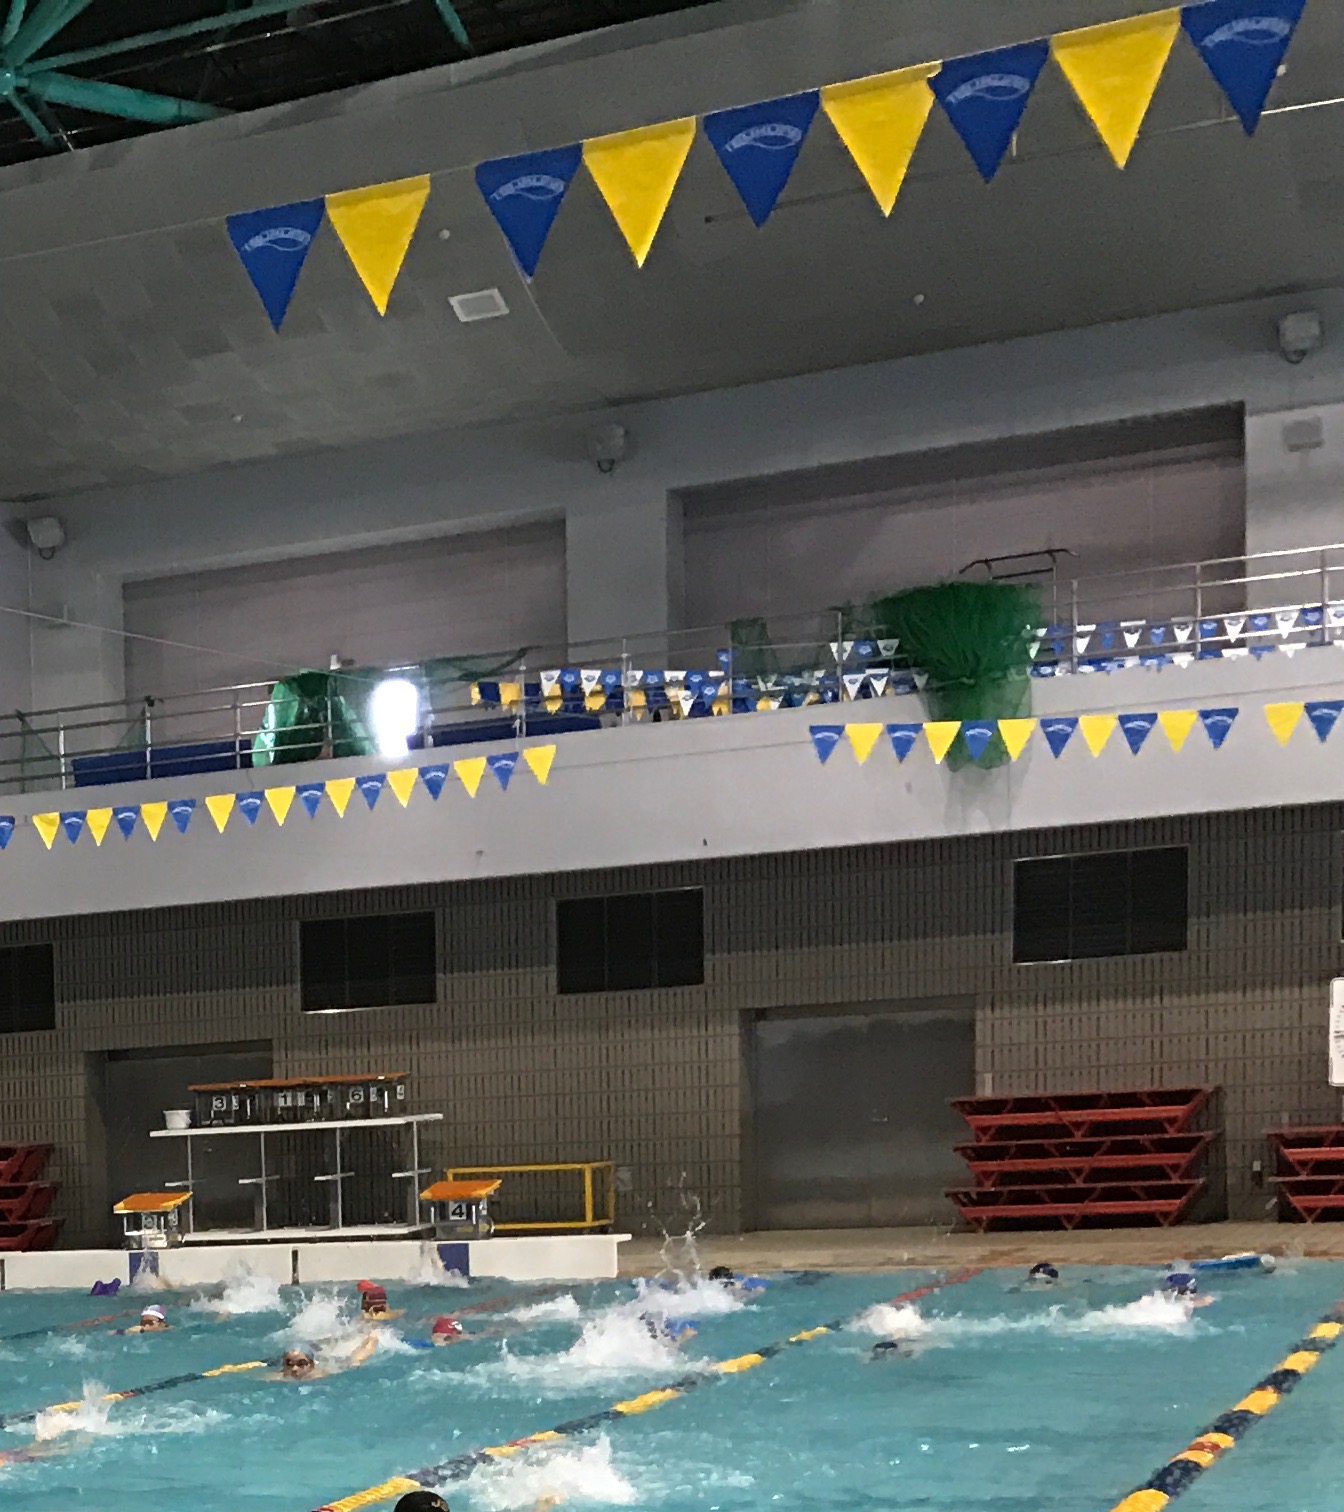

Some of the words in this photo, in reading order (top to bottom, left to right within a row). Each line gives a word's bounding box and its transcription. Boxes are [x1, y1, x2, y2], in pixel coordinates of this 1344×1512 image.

[352, 1089, 363, 1101] 6
[214, 1096, 225, 1109] 3
[451, 1203, 465, 1218] 4
